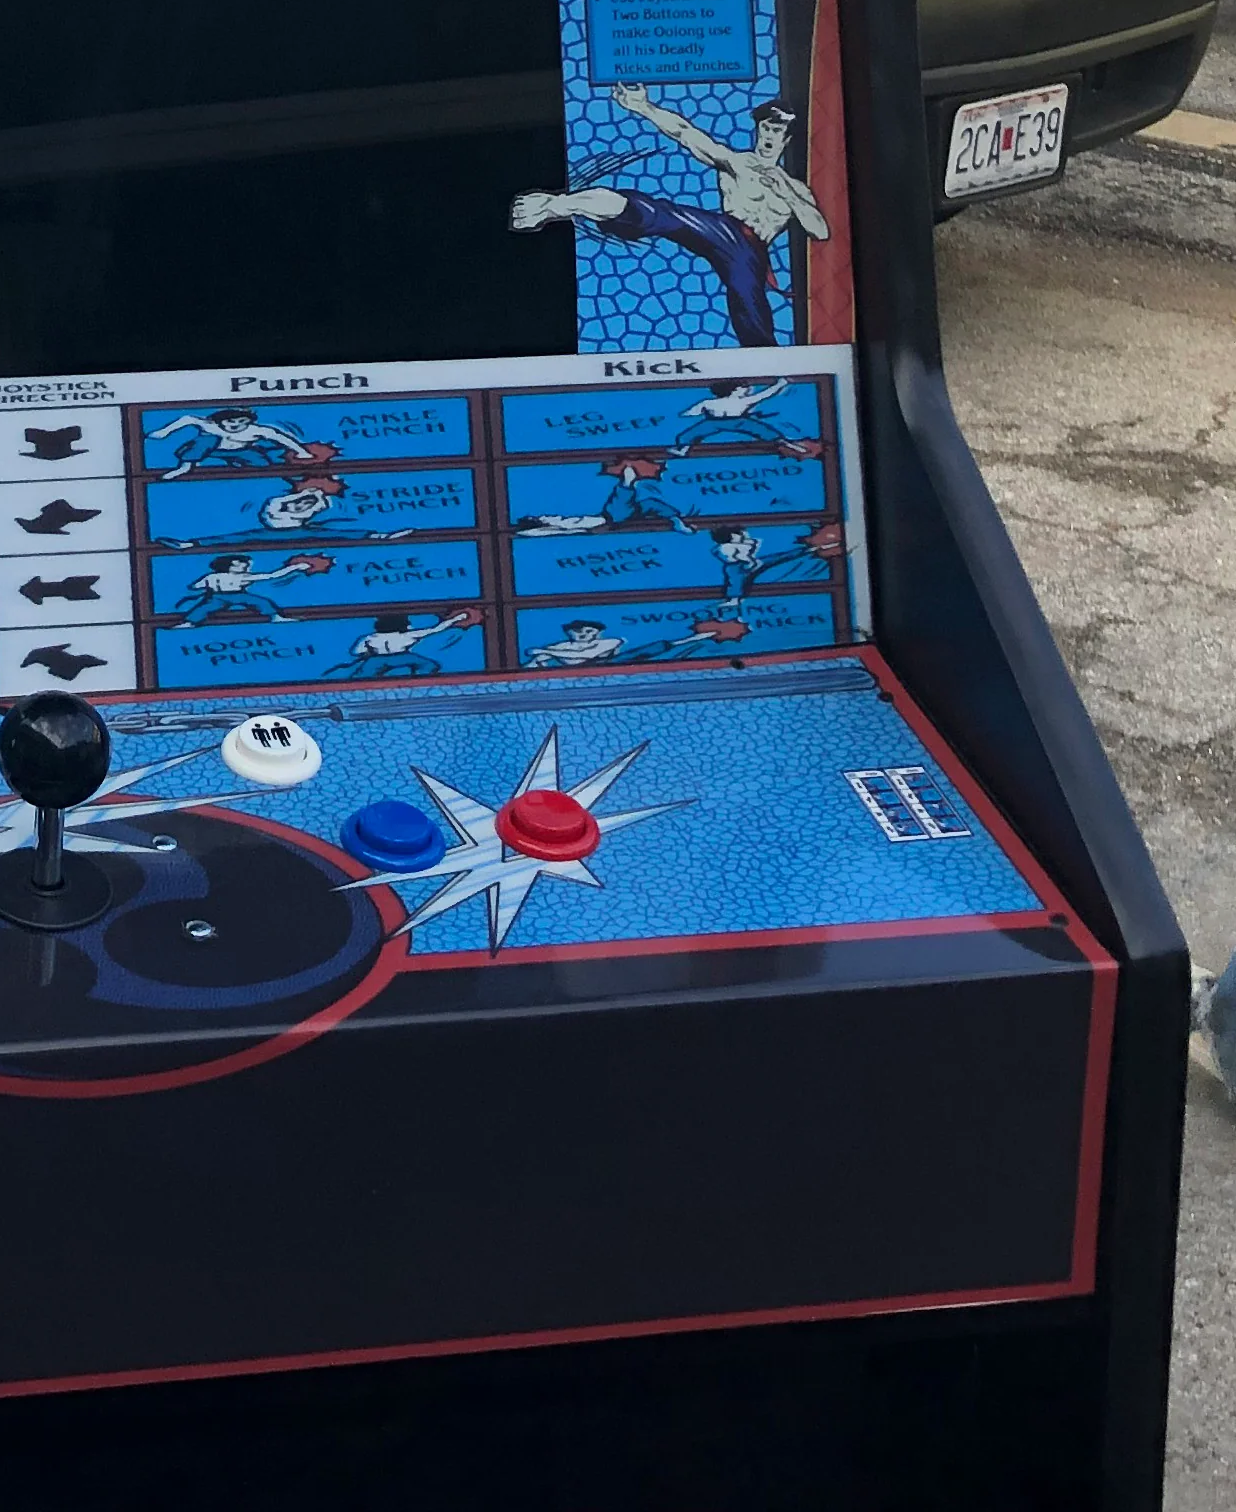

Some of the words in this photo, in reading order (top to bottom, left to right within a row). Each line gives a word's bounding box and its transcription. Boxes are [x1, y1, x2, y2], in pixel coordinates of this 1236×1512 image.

[612, 9, 639, 21] Two
[643, 8, 696, 20] Buttons
[700, 8, 714, 18] to
[612, 27, 650, 38] make
[653, 26, 704, 40] Oolong
[708, 26, 732, 36] use
[614, 45, 631, 56] all
[635, 44, 655, 55] his
[659, 43, 705, 57] Deadly
[614, 62, 651, 75] Kicks
[655, 61, 680, 73] and
[955, 119, 1003, 175] 2CA
[1014, 107, 1061, 162] E39
[603, 359, 702, 376] Kick
[230, 373, 370, 392] Punch
[338, 409, 438, 426] ANKLE
[544, 411, 605, 428] LEG
[343, 423, 445, 439] PUNCH
[566, 415, 665, 439] SWEEP
[671, 464, 803, 484] GROUND
[351, 481, 465, 501] STRIDE
[699, 480, 772, 495] KICK
[356, 496, 462, 514] PUNCH
[556, 544, 661, 568] RISING
[346, 557, 424, 574] FACE
[590, 559, 663, 577] KICK
[364, 567, 468, 587] PUNCH
[620, 603, 789, 624] SWOOPING
[755, 613, 826, 629] KICK
[180, 636, 275, 656] HOOK
[210, 645, 315, 666] PUNCH
